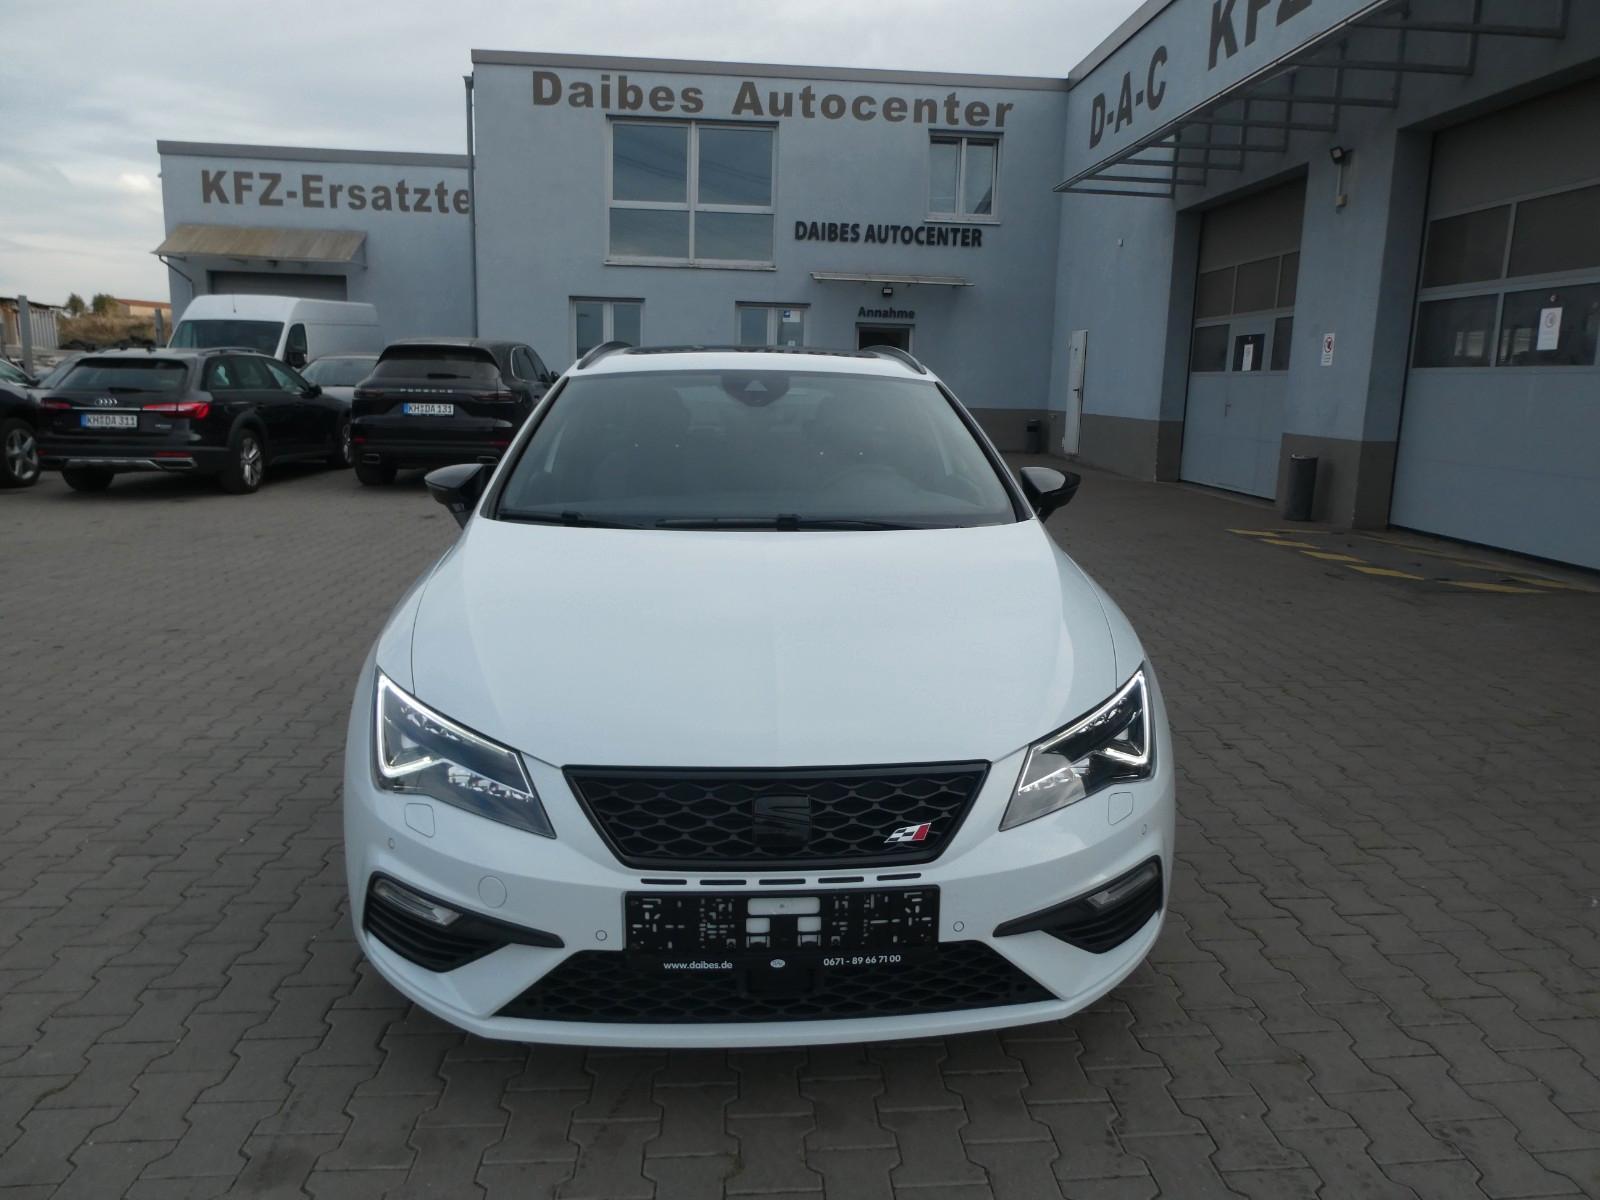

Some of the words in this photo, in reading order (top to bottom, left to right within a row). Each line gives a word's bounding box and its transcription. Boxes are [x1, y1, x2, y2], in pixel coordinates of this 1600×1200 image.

[532, 70, 704, 113] Daibes
[731, 81, 1014, 128] Autocenter
[1089, 45, 1168, 149] D-A-C
[794, 221, 861, 243] DAIBES
[864, 224, 982, 247] AUTOCENTER
[857, 306, 915, 319] Annahme
[663, 960, 733, 969] www.daibes.de
[823, 957, 844, 966] 0671
[851, 956, 863, 965] 89
[865, 955, 877, 964] 66
[878, 955, 888, 963] 71
[889, 954, 902, 963] 00
